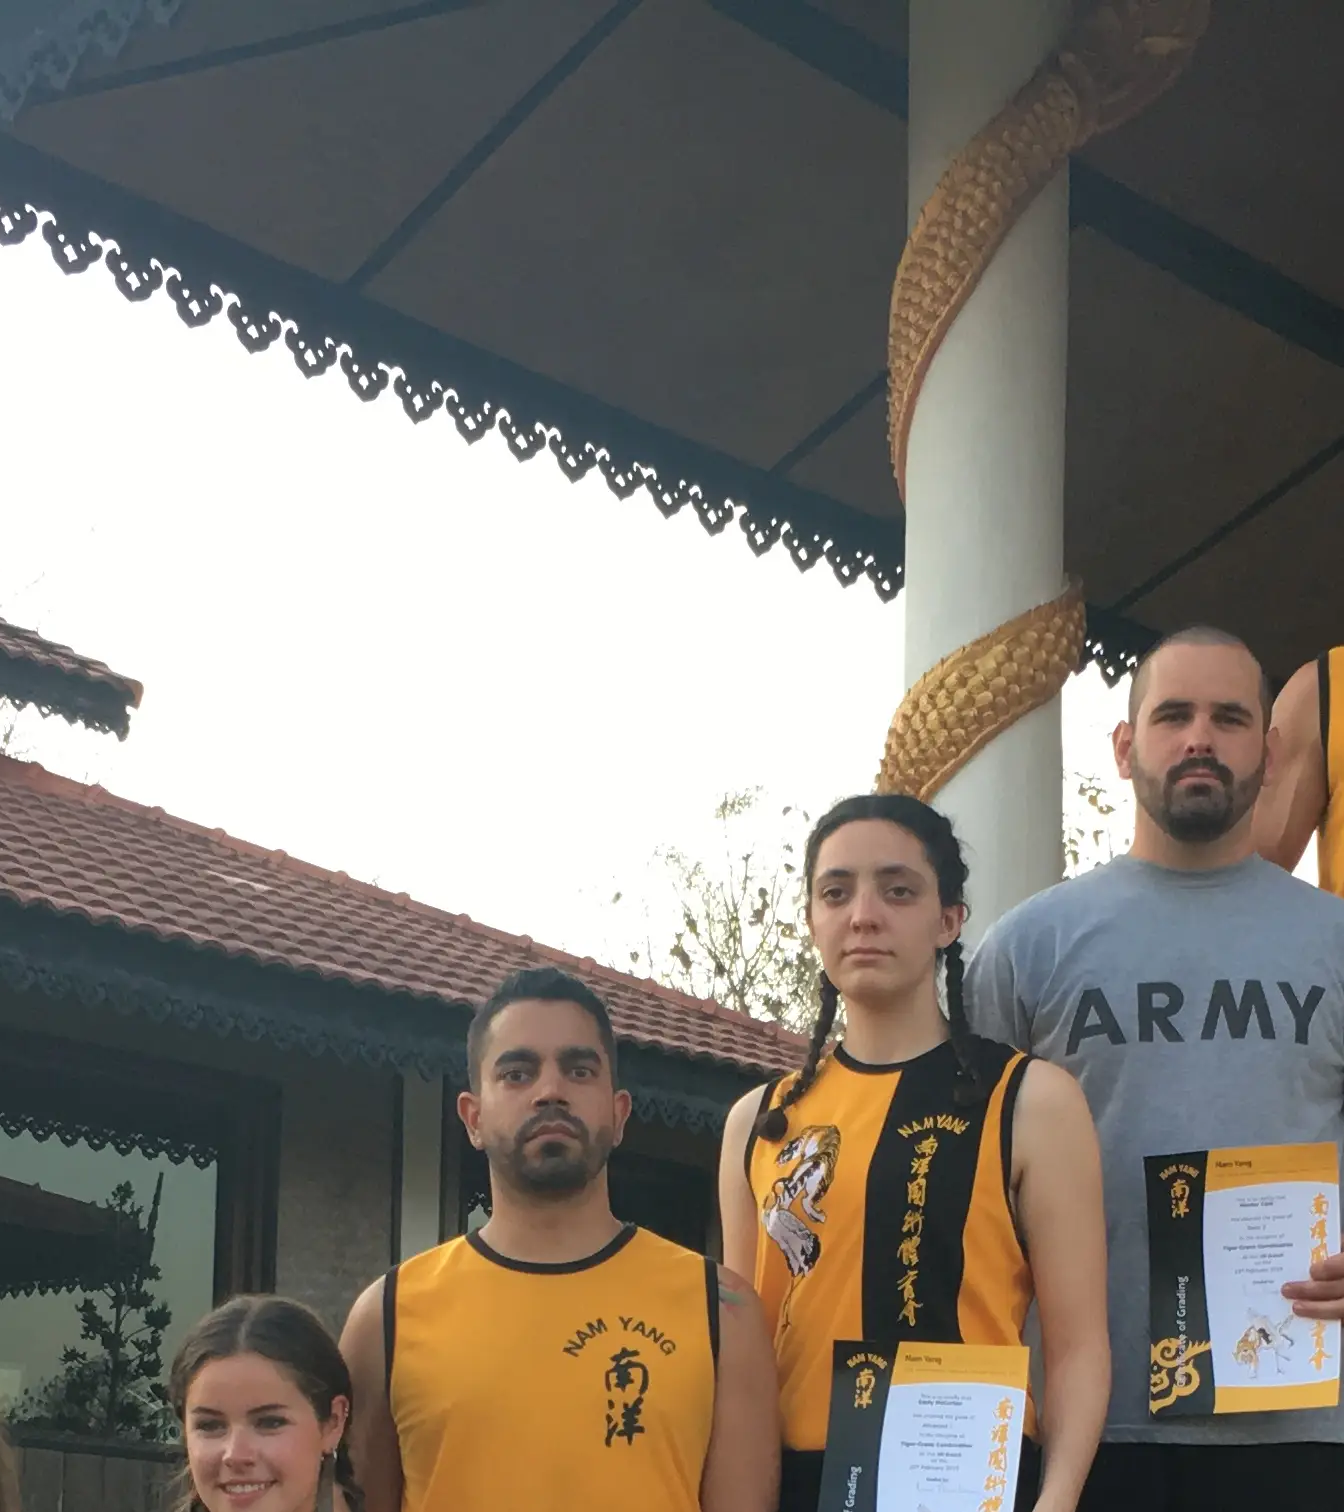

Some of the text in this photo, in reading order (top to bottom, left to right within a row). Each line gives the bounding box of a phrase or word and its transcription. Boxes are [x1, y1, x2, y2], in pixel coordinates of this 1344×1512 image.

[1064, 978, 1326, 1056] ARMY
[897, 1113, 970, 1138] NAM YANG
[1159, 1164, 1177, 1180] NAM
[1178, 1164, 1199, 1178] YANG
[1170, 1179, 1190, 1218] 南洋
[1176, 1276, 1189, 1317] Grading
[562, 1316, 676, 1357] NAM YANG
[1176, 1319, 1186, 1331] of
[846, 1353, 887, 1369] NAM YANG
[605, 1346, 649, 1448] 南洋
[854, 1368, 875, 1409] 南洋
[845, 1466, 862, 1507] Grading
